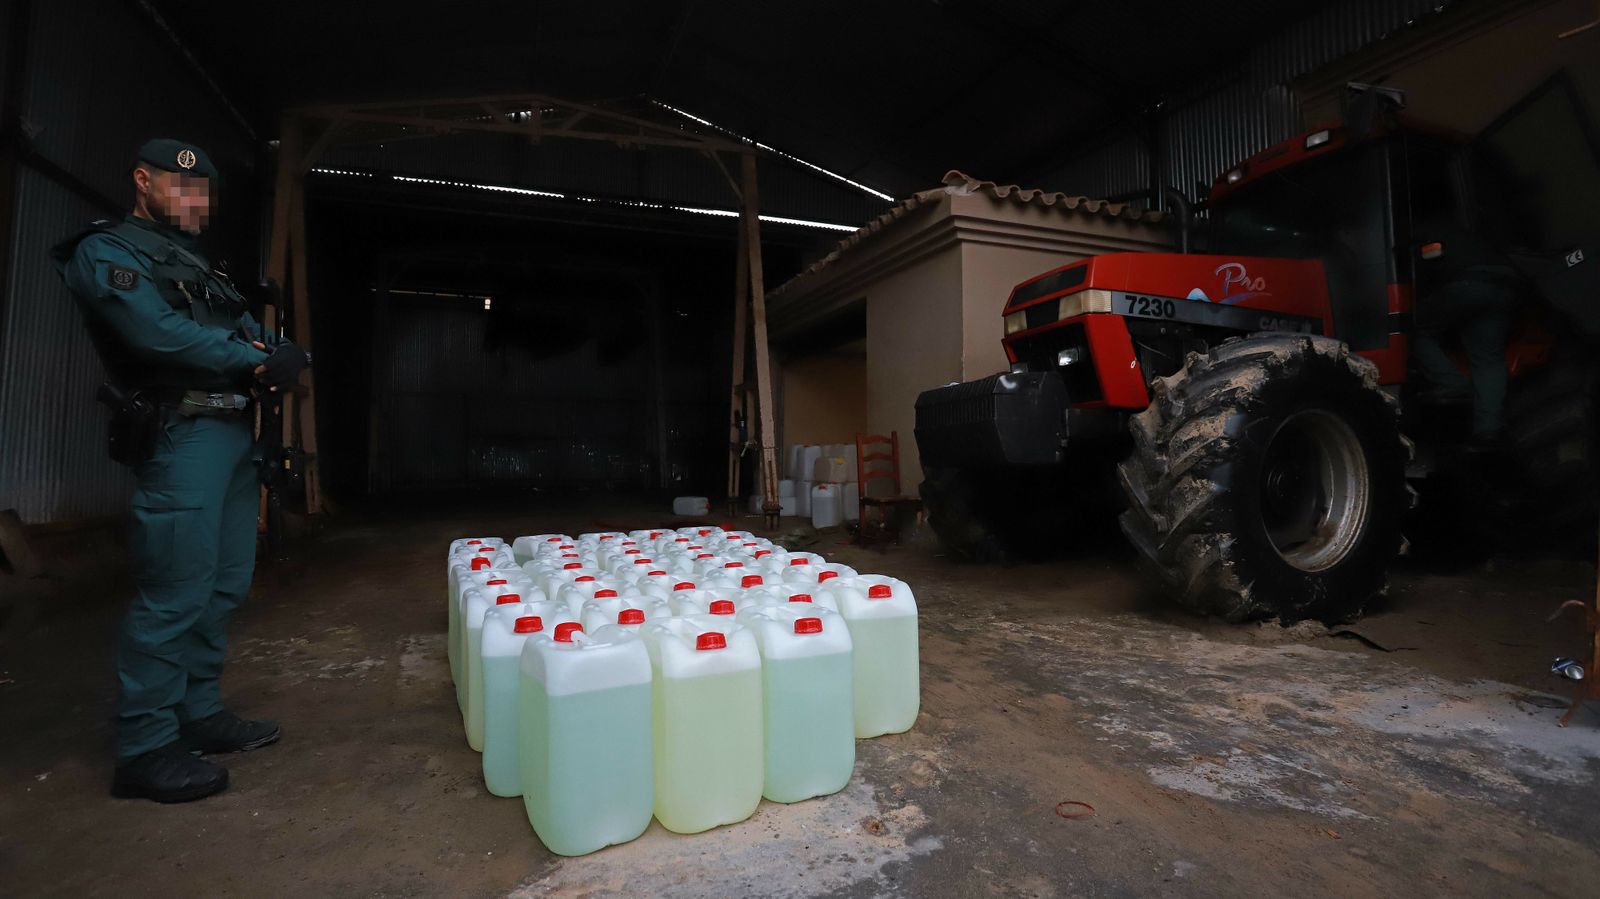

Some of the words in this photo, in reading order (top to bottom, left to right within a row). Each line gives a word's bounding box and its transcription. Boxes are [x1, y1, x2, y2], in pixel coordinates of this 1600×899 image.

[1568, 250, 1582, 265] CE
[1215, 262, 1266, 296] Pro
[1126, 295, 1175, 318] 7230
